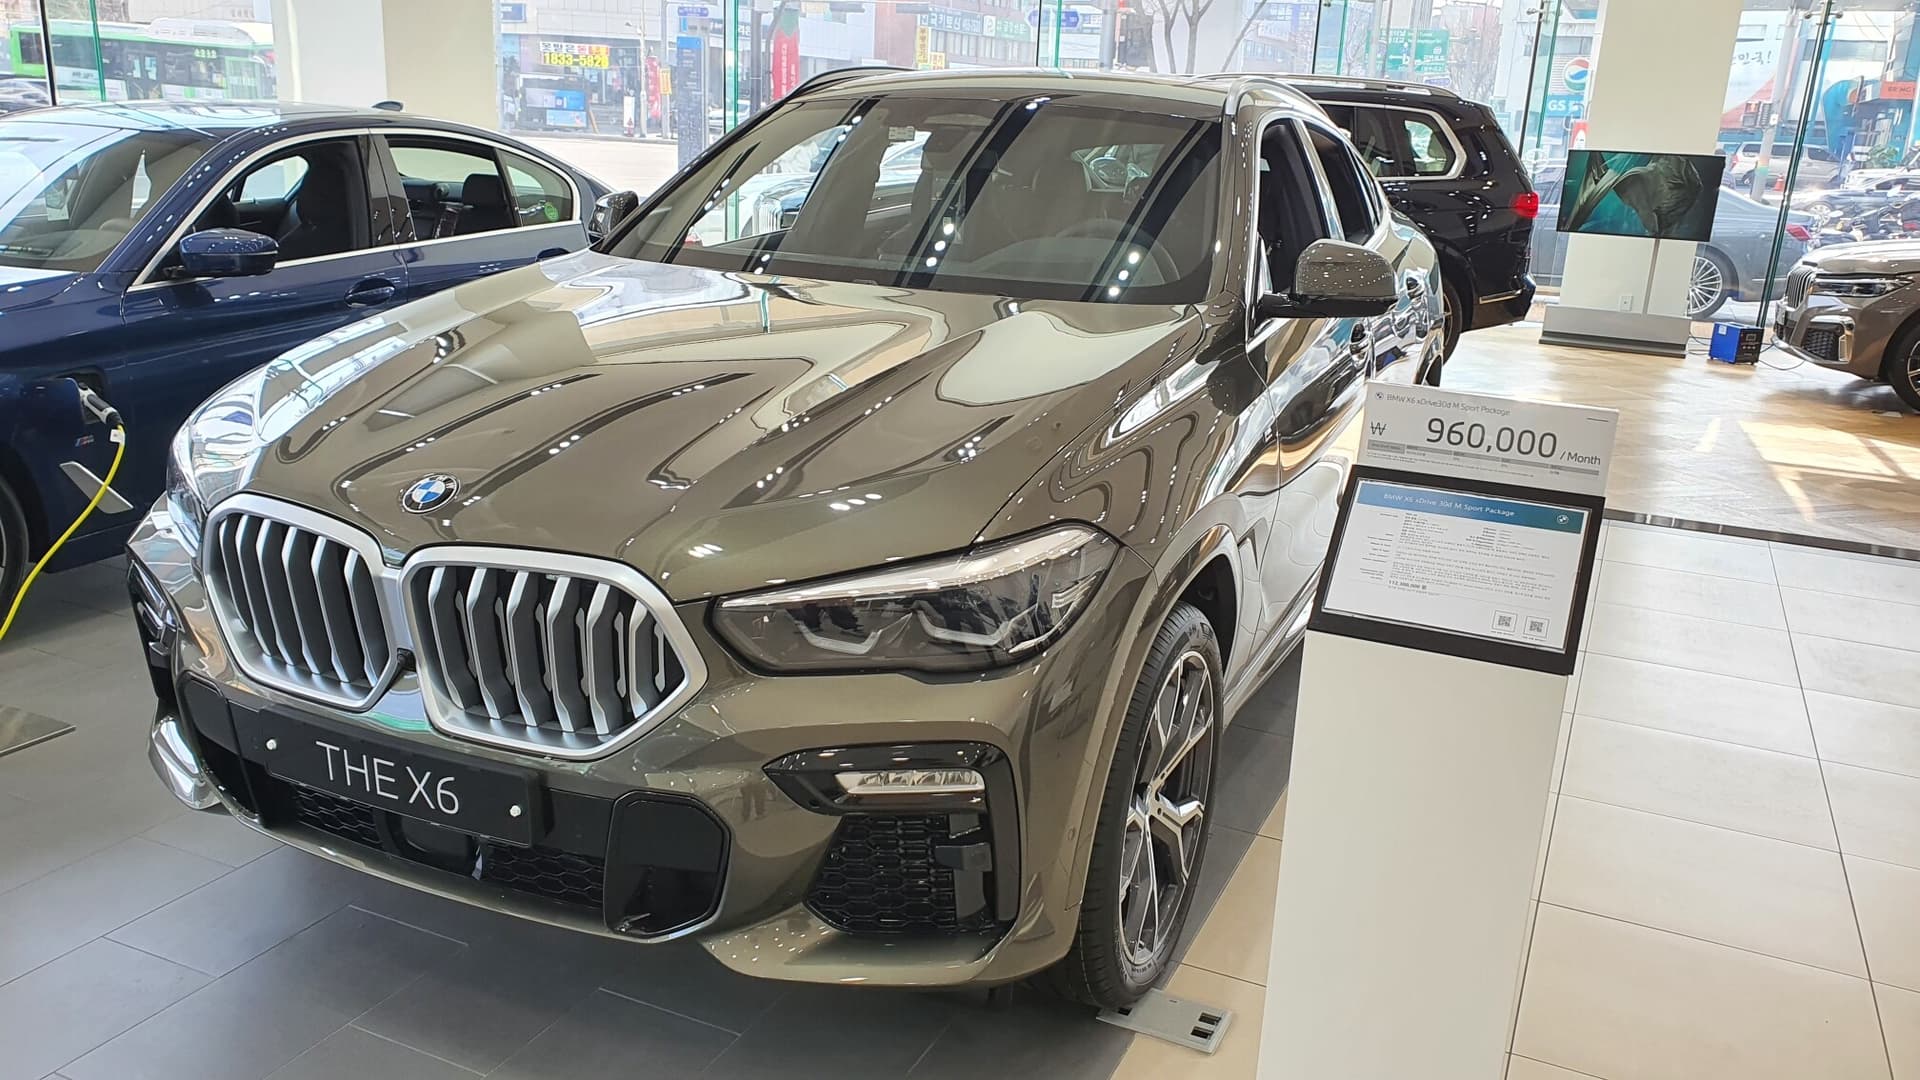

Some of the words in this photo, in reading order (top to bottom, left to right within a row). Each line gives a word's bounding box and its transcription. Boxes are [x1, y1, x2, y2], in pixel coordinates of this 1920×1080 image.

[1549, 100, 1567, 111] GS
[1386, 393, 1405, 402] BMW
[1406, 396, 1416, 404] X6
[1460, 403, 1479, 413] Sport
[1480, 405, 1511, 416] Package
[1426, 417, 1557, 458] 960,000
[1383, 492, 1402, 501] BMW
[1415, 496, 1437, 507] xDrive
[1454, 502, 1463, 510] M
[1463, 504, 1484, 513] Sport
[1485, 506, 1516, 517] Package
[315, 740, 399, 800] THE
[405, 765, 460, 815] X6
